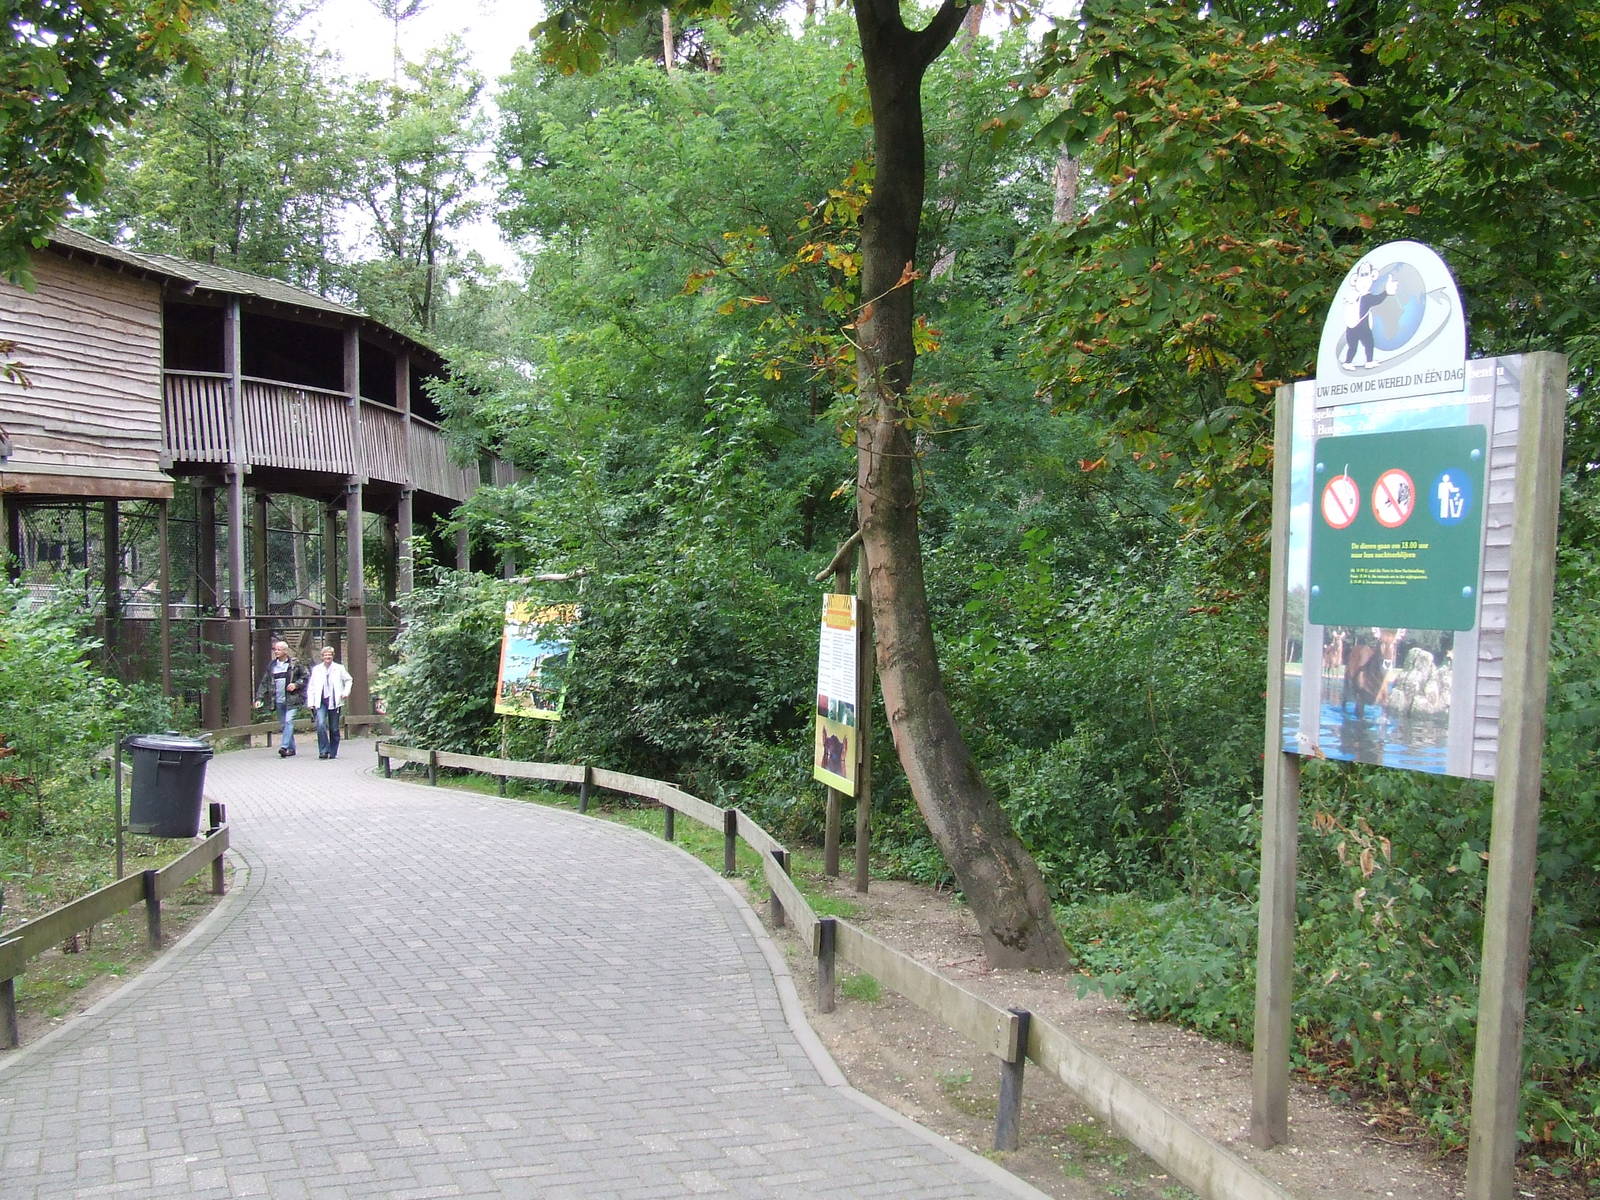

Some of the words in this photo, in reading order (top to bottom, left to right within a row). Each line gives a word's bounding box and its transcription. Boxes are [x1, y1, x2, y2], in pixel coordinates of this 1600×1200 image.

[1316, 386, 1330, 397] UW
[1330, 384, 1349, 396] REIS
[1350, 382, 1363, 393] OM
[1364, 380, 1377, 391] DE
[1378, 375, 1411, 389] WERELD
[1413, 374, 1424, 384] IN
[1425, 369, 1442, 383] ÉÉN
[1444, 368, 1464, 380] DAG
